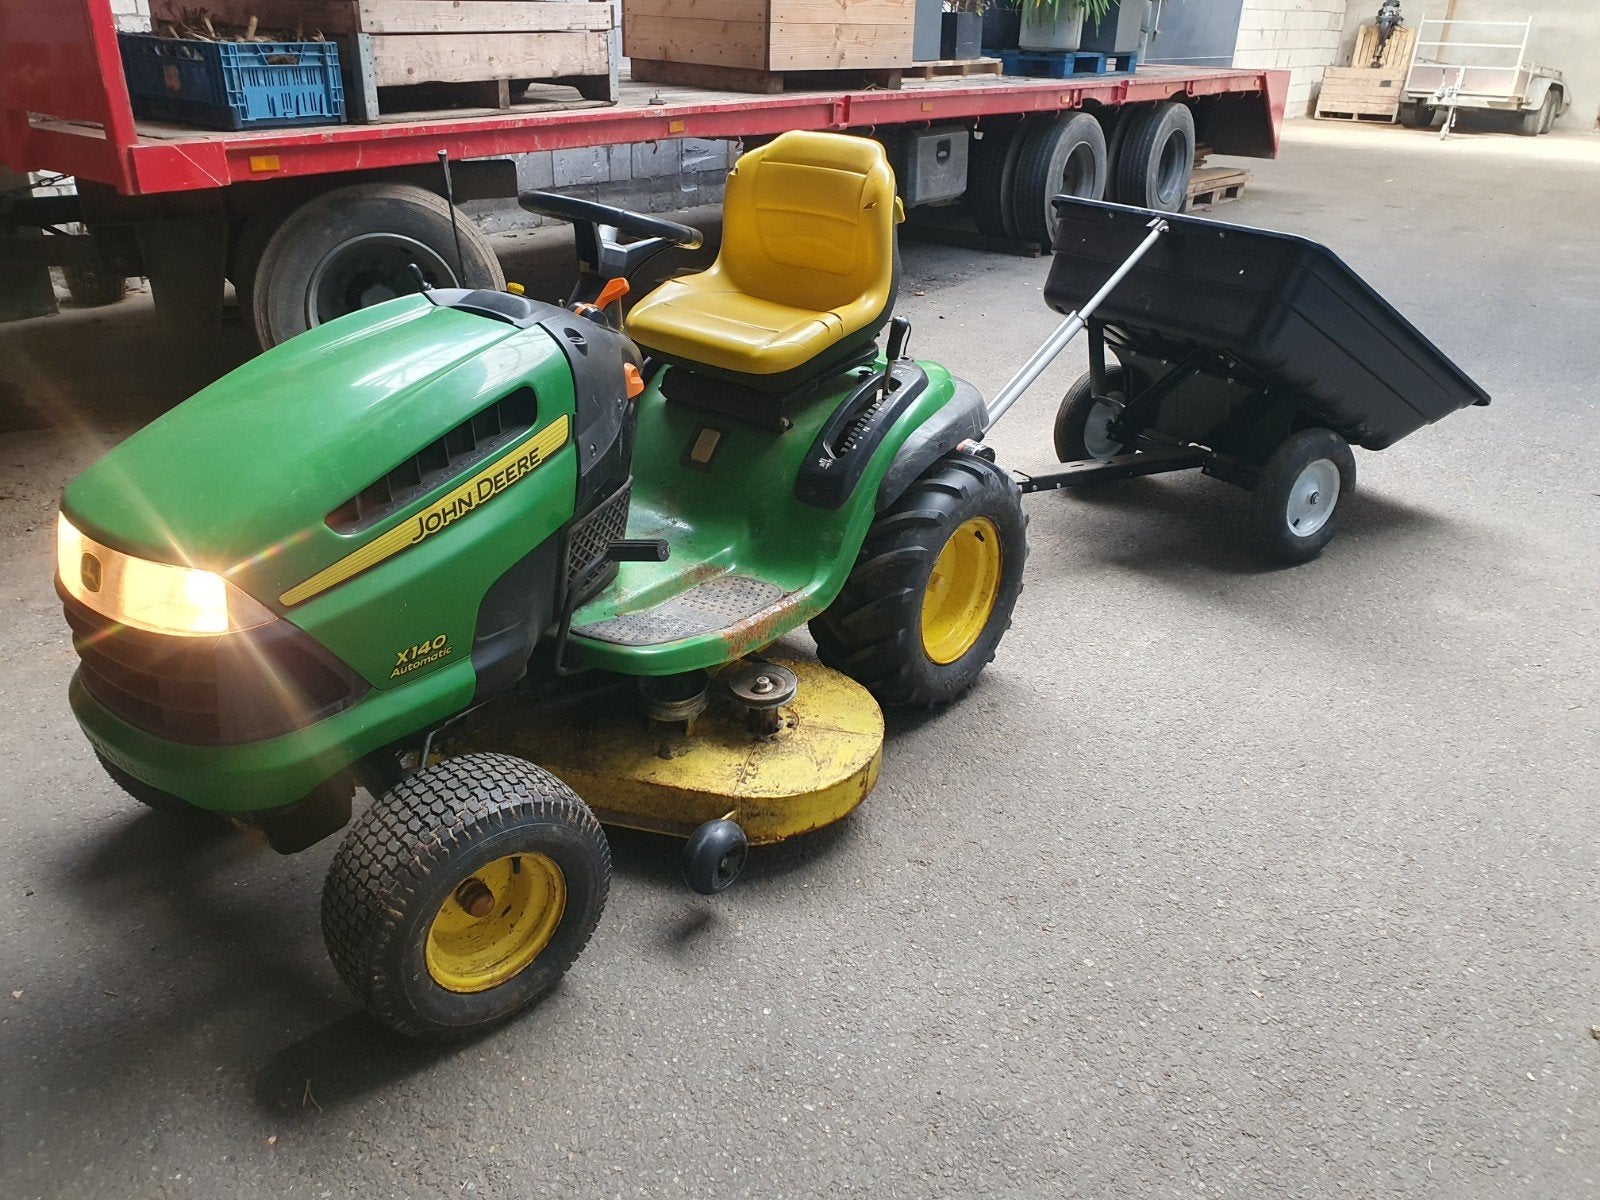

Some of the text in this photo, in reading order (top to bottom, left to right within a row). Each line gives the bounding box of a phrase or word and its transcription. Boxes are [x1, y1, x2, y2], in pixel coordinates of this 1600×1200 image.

[412, 446, 541, 542] JOHN DEERE
[389, 646, 453, 679] Automatic
[396, 634, 447, 665] X140
